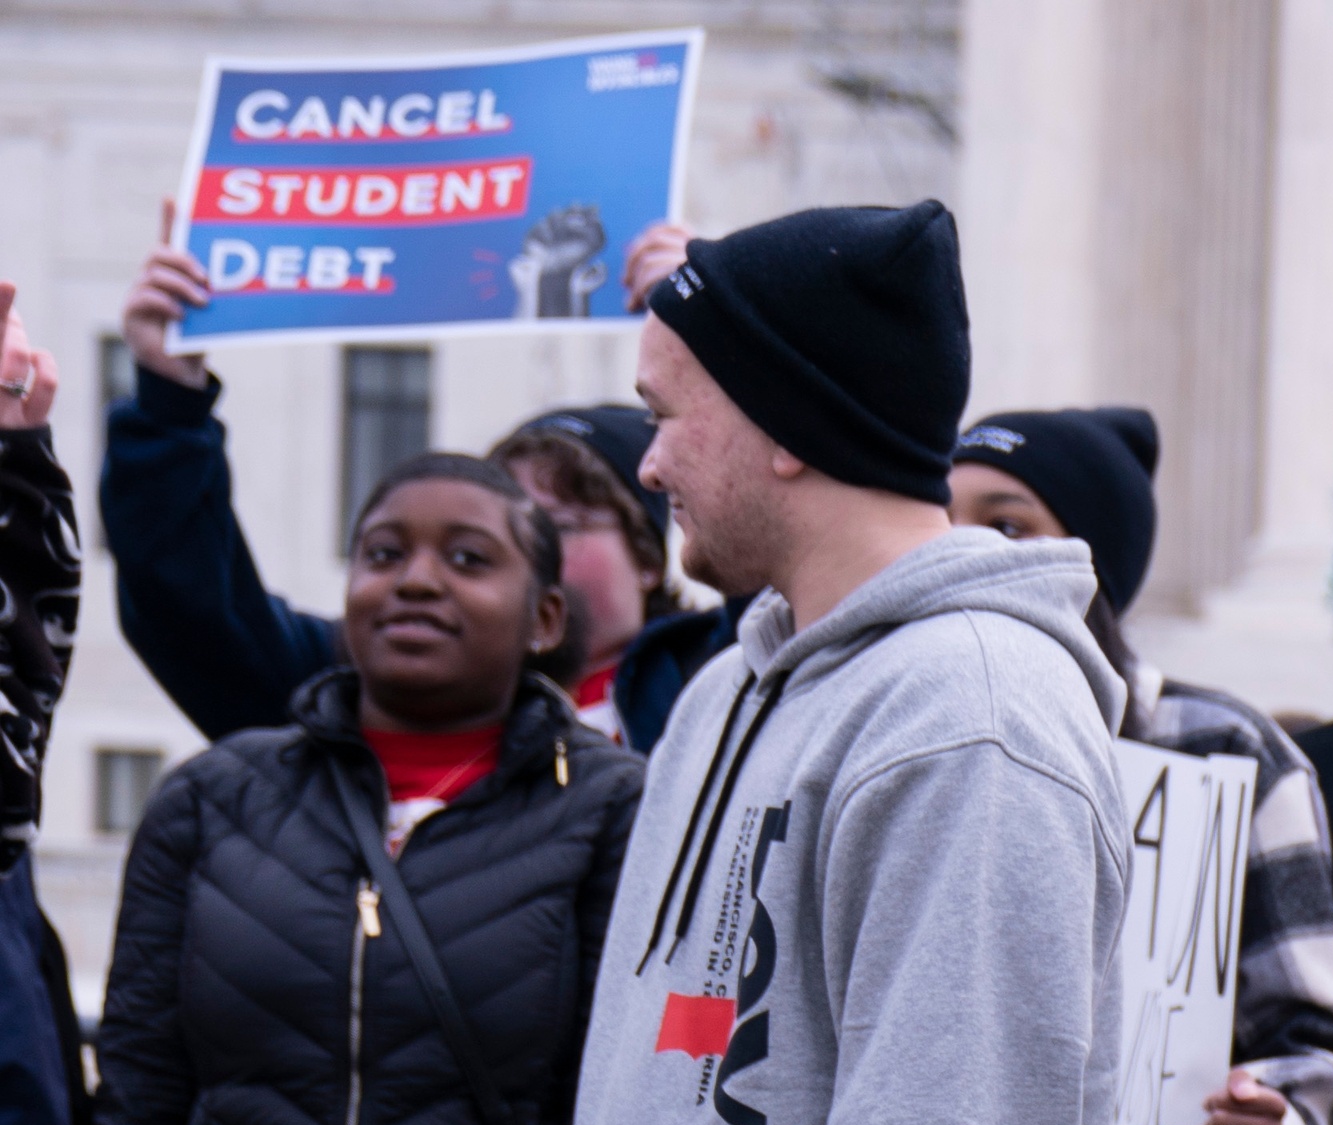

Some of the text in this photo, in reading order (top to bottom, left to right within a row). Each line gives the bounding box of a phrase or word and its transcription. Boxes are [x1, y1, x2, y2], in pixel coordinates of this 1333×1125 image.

[235, 89, 511, 140] CANCEL
[217, 166, 525, 217] STUDENT
[208, 238, 396, 291] DEBT
